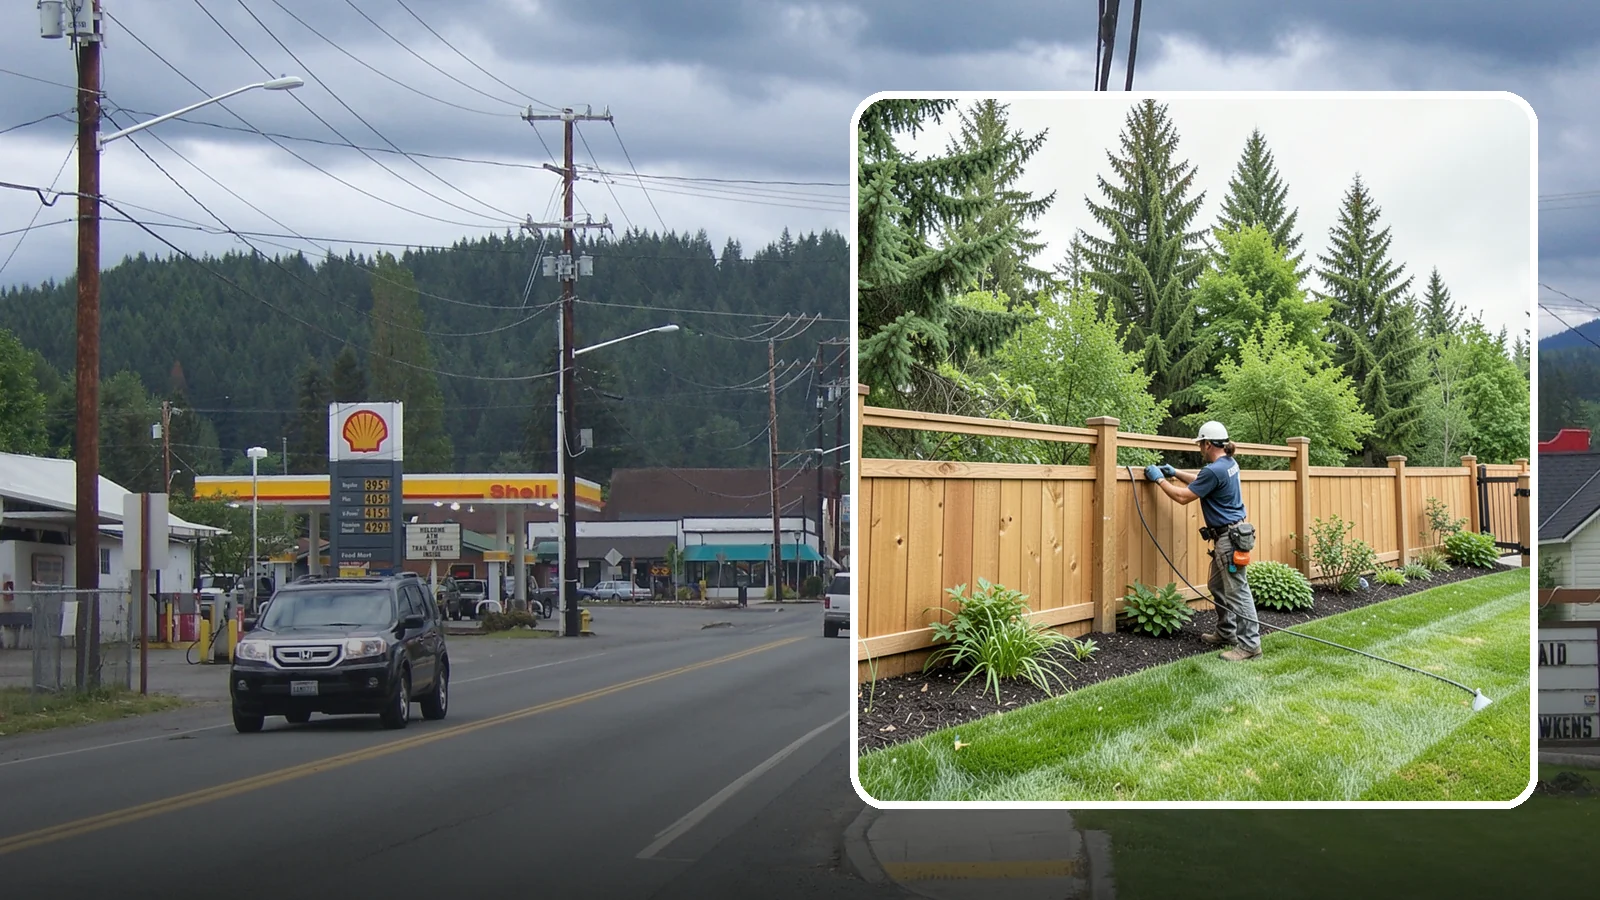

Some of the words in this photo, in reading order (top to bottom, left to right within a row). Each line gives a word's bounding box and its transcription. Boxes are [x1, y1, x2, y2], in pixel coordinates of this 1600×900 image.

[366, 480, 384, 490] 395
[490, 484, 547, 498] Shell
[366, 494, 384, 504] 405
[365, 508, 383, 518] 415
[366, 522, 384, 532] 429
